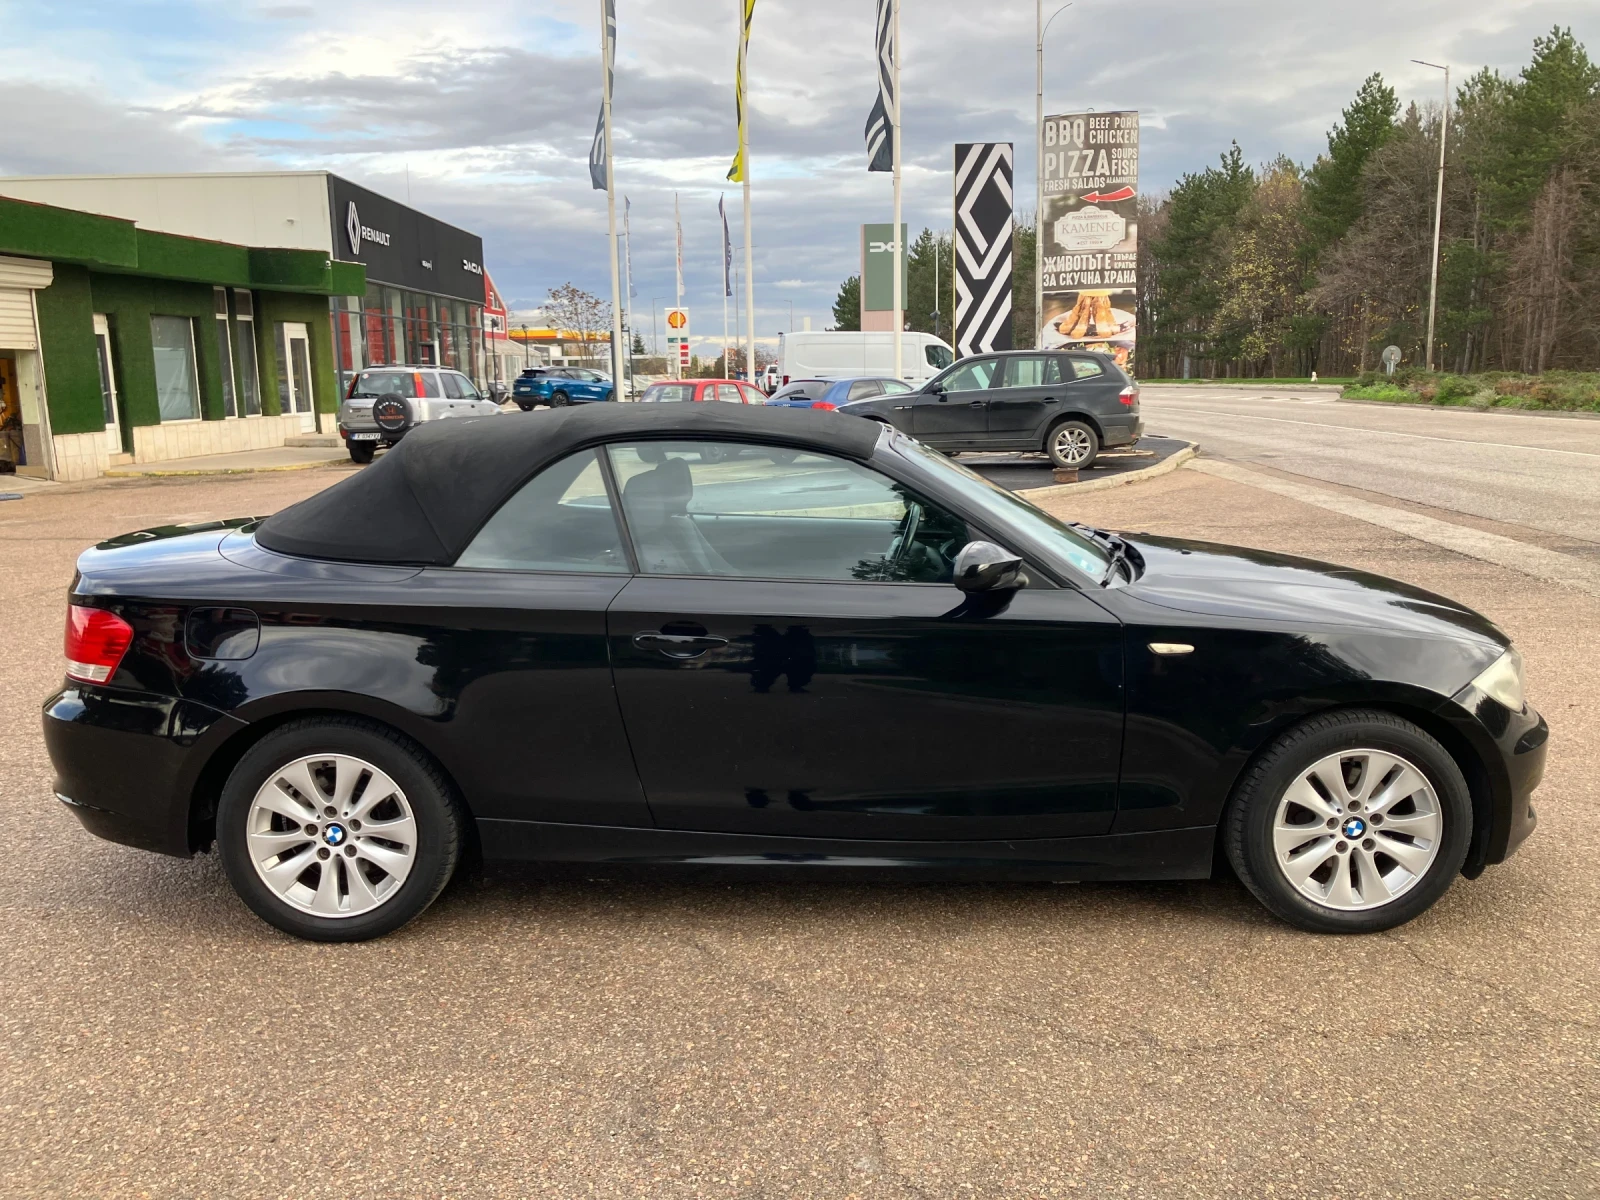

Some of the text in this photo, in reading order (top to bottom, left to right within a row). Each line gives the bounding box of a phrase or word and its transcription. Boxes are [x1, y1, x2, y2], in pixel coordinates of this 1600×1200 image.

[1089, 116, 1138, 129] BEEF PORK
[1045, 118, 1085, 148] BBQ
[1089, 129, 1138, 144] CHICKEN
[1111, 147, 1137, 159] SOUPS
[1044, 149, 1110, 179] PIZZA
[1111, 159, 1137, 176] FISH
[1044, 176, 1106, 192] FRESH SALADS
[361, 225, 391, 247] RENAULT
[1061, 221, 1120, 235] KAMENEC
[1043, 253, 1111, 273] ЖИВОТЪТ Е
[1043, 269, 1137, 287] ЗА СКУЧНА ХРАНА
